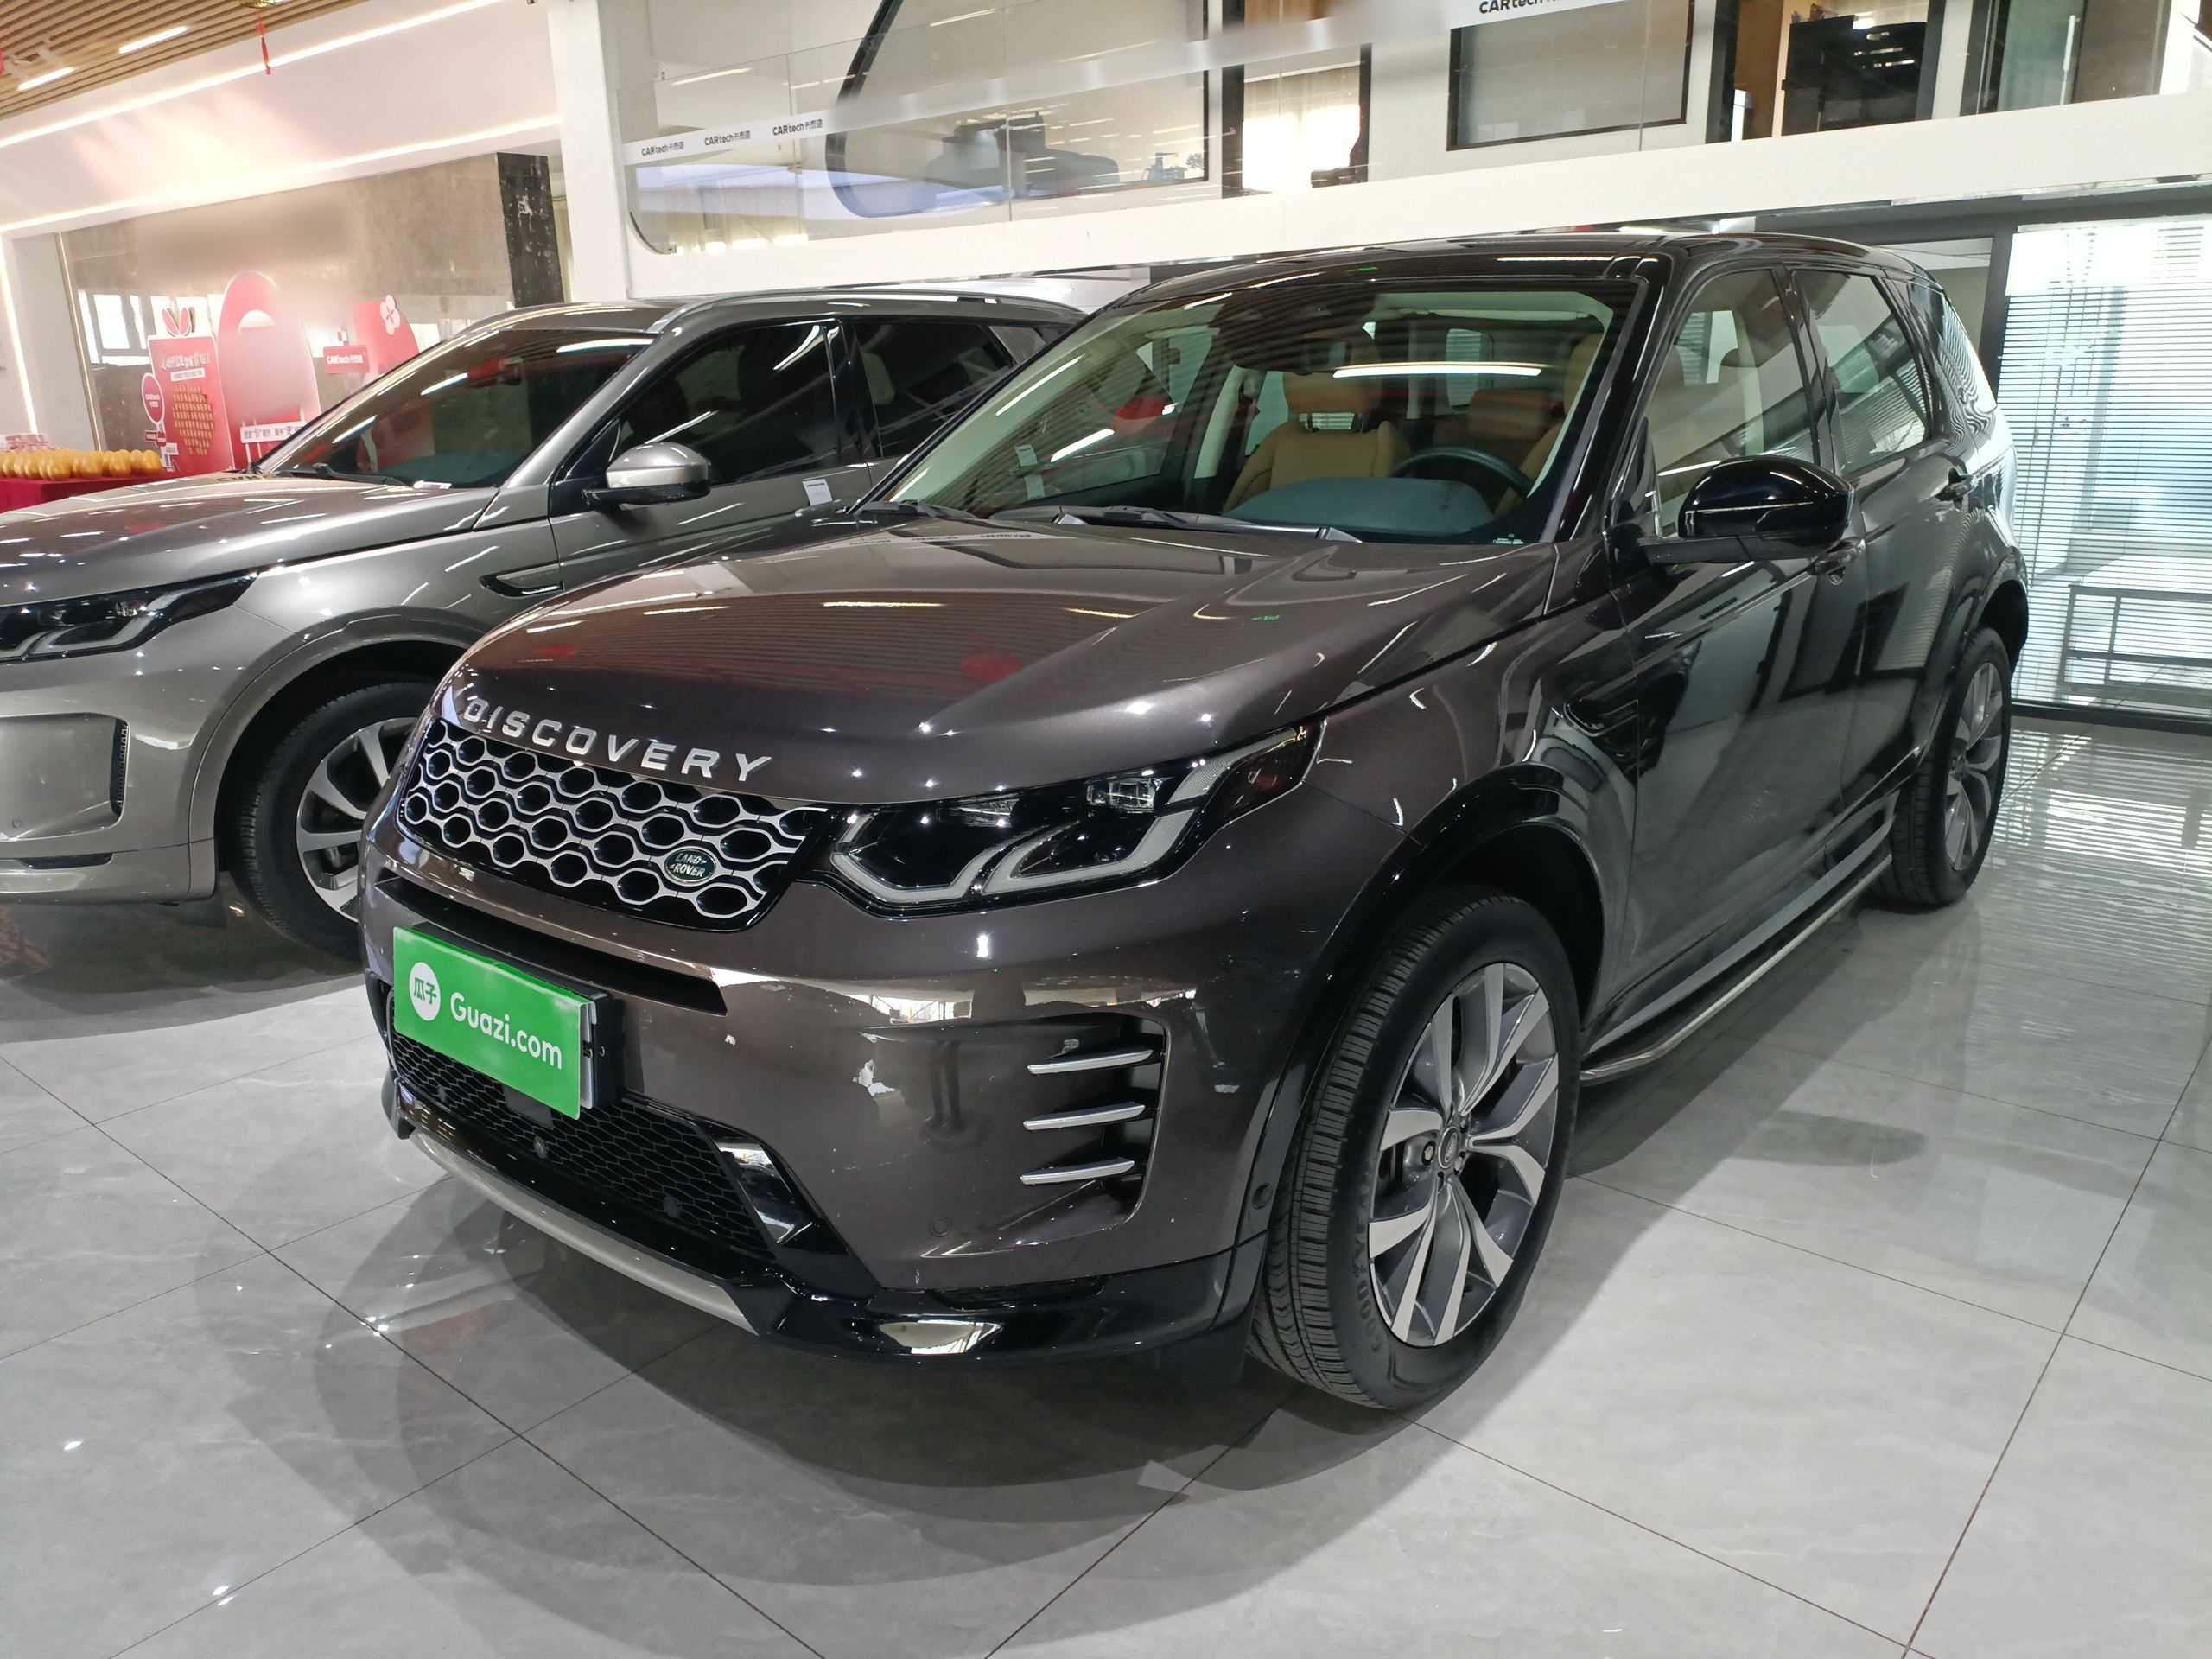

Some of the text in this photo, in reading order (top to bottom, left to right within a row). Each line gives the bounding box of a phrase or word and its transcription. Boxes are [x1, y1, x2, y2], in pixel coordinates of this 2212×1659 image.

[462, 697, 773, 783] DISCOVERY
[673, 864, 706, 877] ROVER
[675, 852, 702, 865] LAND
[413, 977, 438, 1005] 瓜子
[450, 991, 563, 1070] Guazi.com
